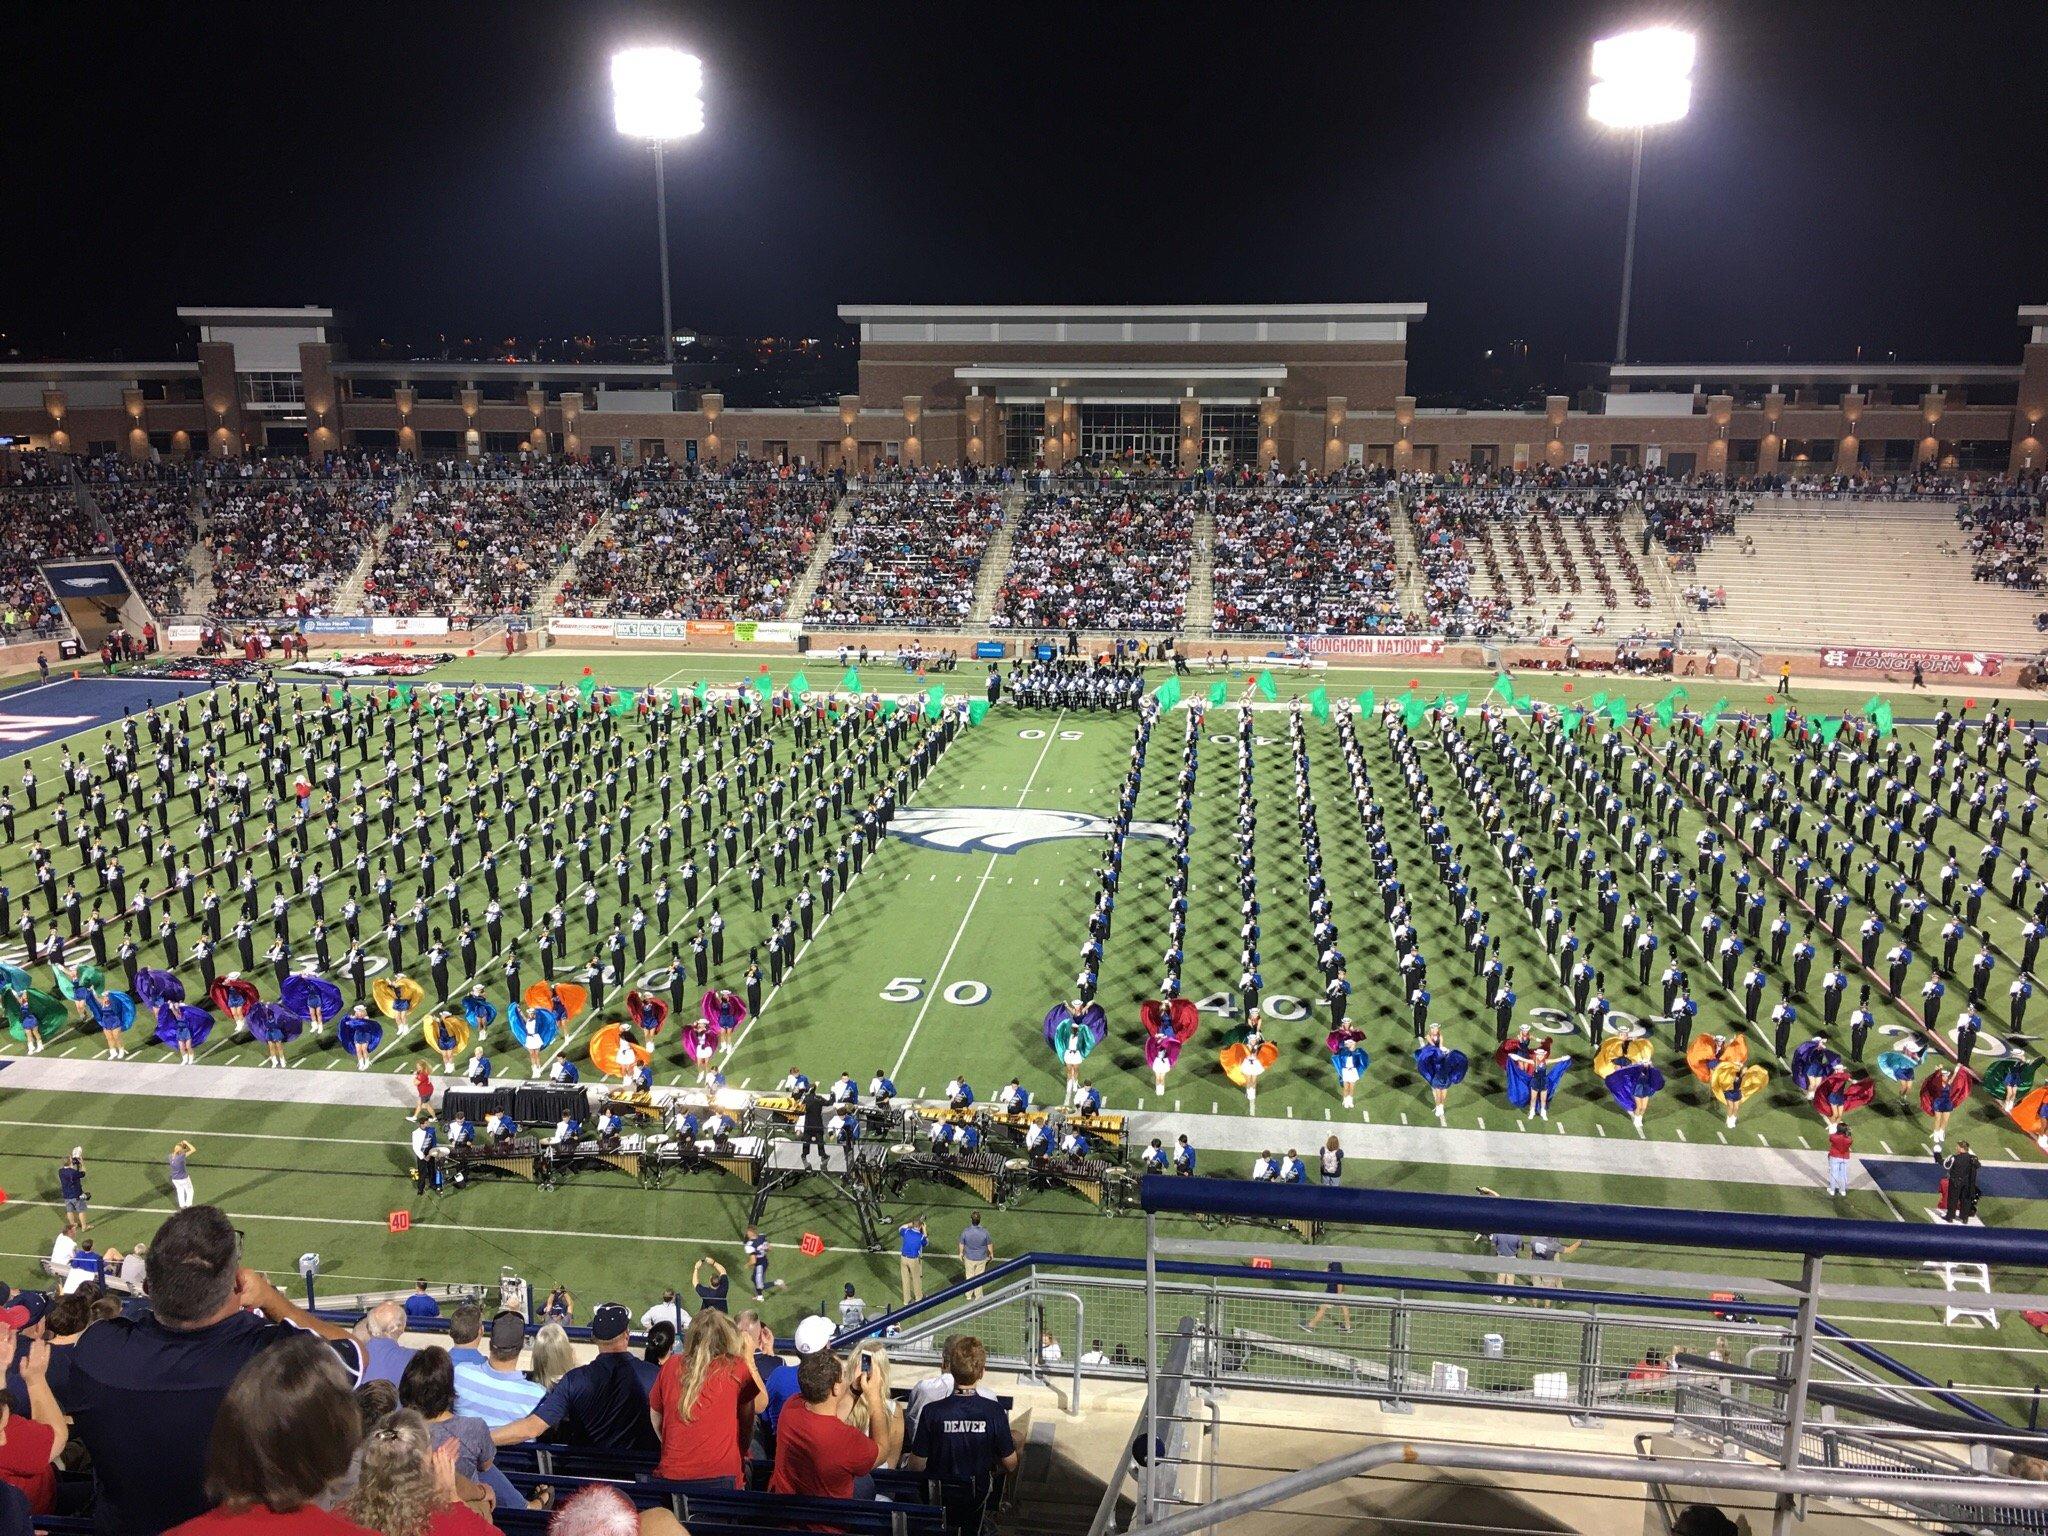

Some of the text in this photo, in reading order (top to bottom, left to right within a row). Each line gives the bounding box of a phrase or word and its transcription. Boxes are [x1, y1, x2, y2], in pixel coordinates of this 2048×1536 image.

[1308, 637, 1421, 654] LONGHORN NATION
[1881, 651, 1909, 659] GREAT
[1853, 656, 1961, 673] LONGHORN
[878, 977, 992, 1006] 50
[1195, 992, 1312, 1020] 40
[391, 1213, 407, 1229] 40
[802, 1237, 817, 1253] 50
[943, 1420, 987, 1433] DEAVER
